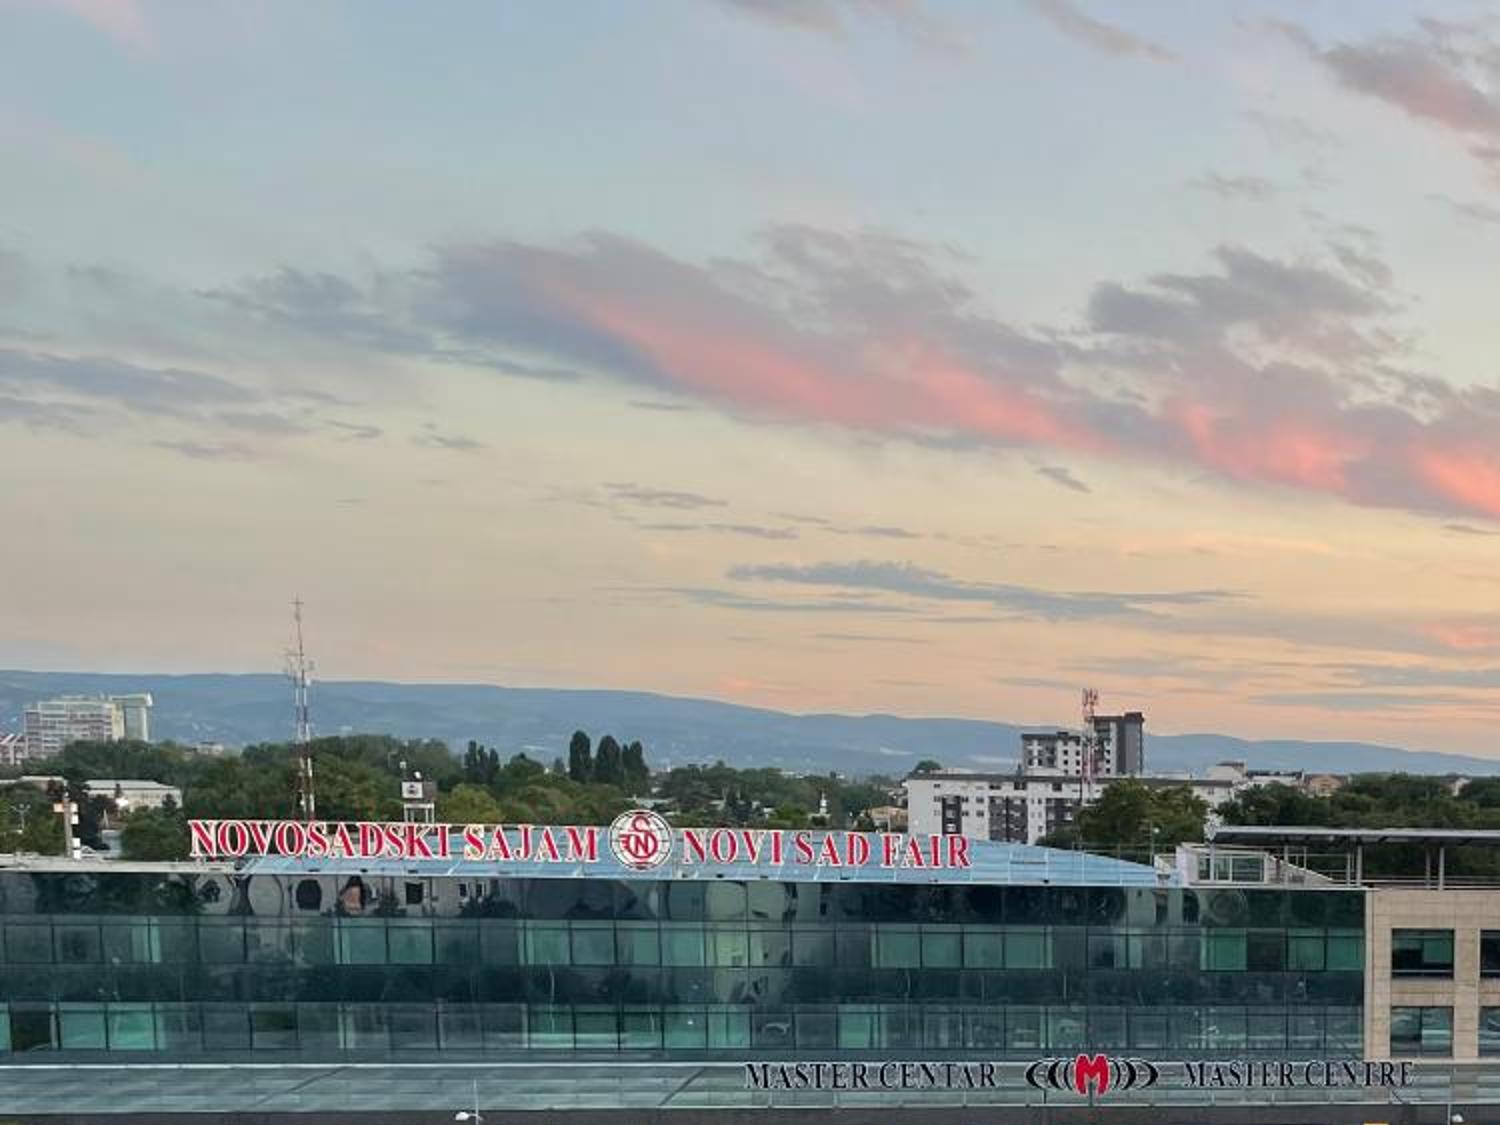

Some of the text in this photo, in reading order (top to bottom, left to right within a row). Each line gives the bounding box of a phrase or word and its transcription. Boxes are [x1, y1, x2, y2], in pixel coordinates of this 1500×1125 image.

[187, 819, 453, 860] NOVOSADSKI
[462, 823, 599, 863] SAJAM
[683, 828, 784, 866] NOVI
[795, 830, 871, 867] SAD
[880, 832, 972, 869] FAIR
[745, 1062, 868, 1089] MASTER
[878, 1062, 997, 1089] CENTAR
[1183, 1061, 1296, 1088] MASTER
[1303, 1060, 1414, 1088] CENTRE
